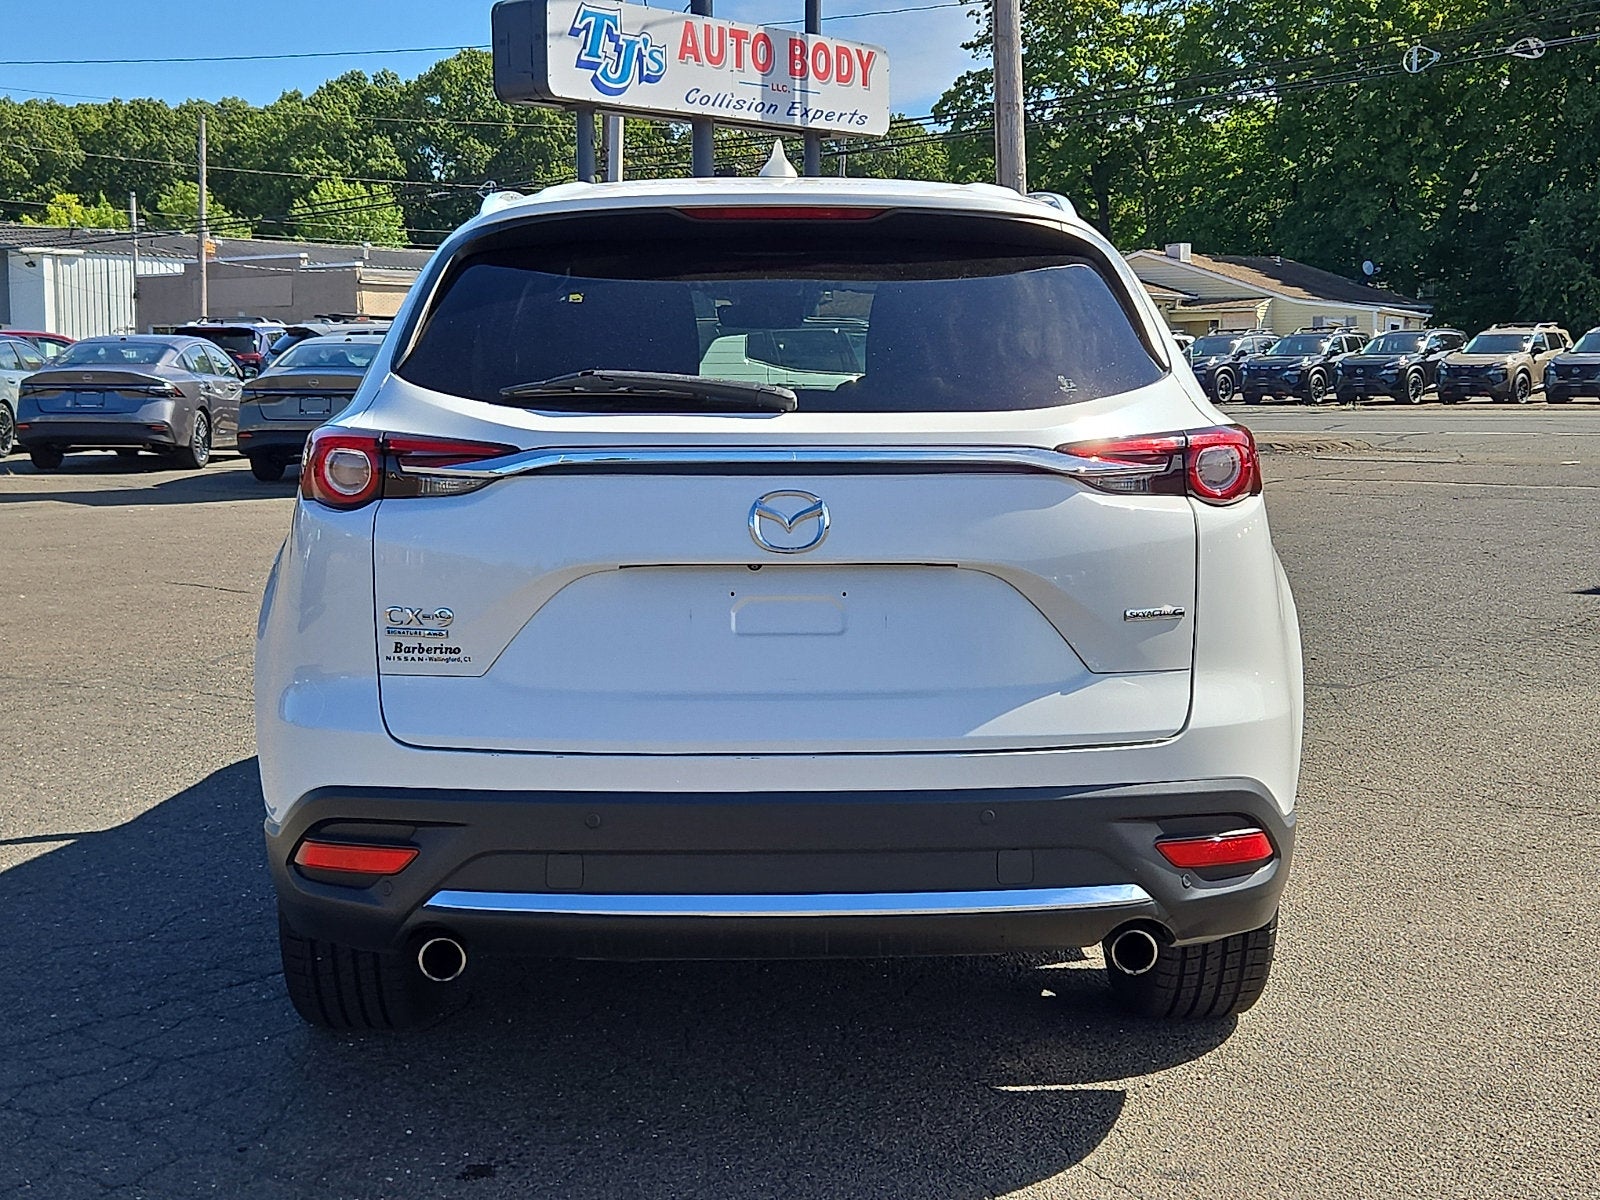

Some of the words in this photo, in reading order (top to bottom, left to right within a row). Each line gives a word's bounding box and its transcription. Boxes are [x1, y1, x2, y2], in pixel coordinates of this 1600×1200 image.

[678, 20, 774, 76] AUTO
[788, 32, 876, 88] BODY
[685, 87, 778, 115] Collision
[787, 101, 869, 127] Experts
[384, 605, 454, 627] CX-9
[393, 641, 462, 655] Barberino
